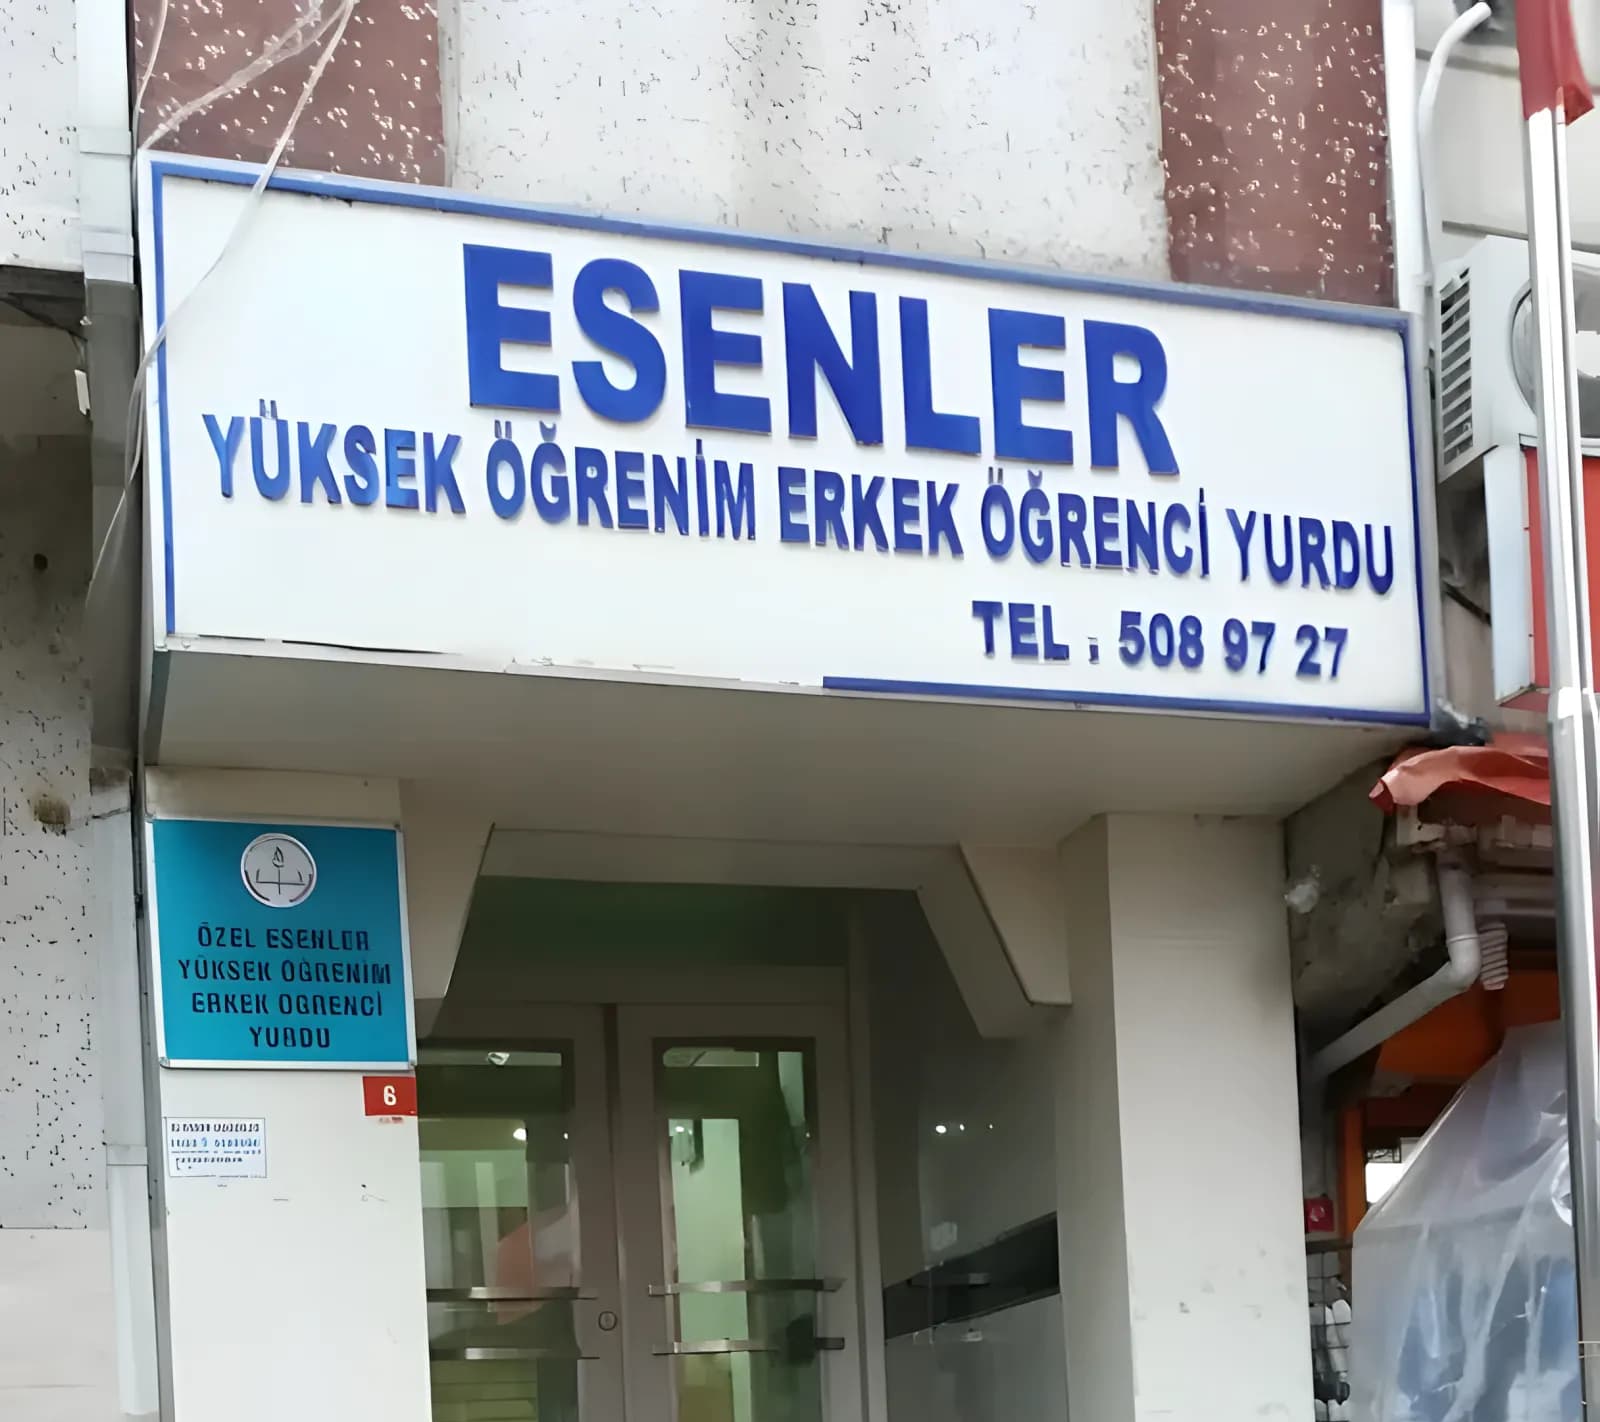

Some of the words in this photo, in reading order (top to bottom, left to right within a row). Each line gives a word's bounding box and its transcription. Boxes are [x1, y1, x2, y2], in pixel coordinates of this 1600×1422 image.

[463, 243, 1180, 475] ESENLER
[202, 399, 466, 514] YÜKSEK
[486, 420, 756, 540] ÖĞRENİM
[777, 465, 964, 559] ERKEK
[980, 467, 1211, 578] ÖĞRENCİ
[1226, 508, 1395, 595] YURDU
[1118, 610, 1204, 669] 508
[1223, 618, 1276, 674] 97
[1296, 624, 1348, 679] 27
[197, 922, 257, 948] ÖZEL
[383, 1084, 397, 1106] 6
